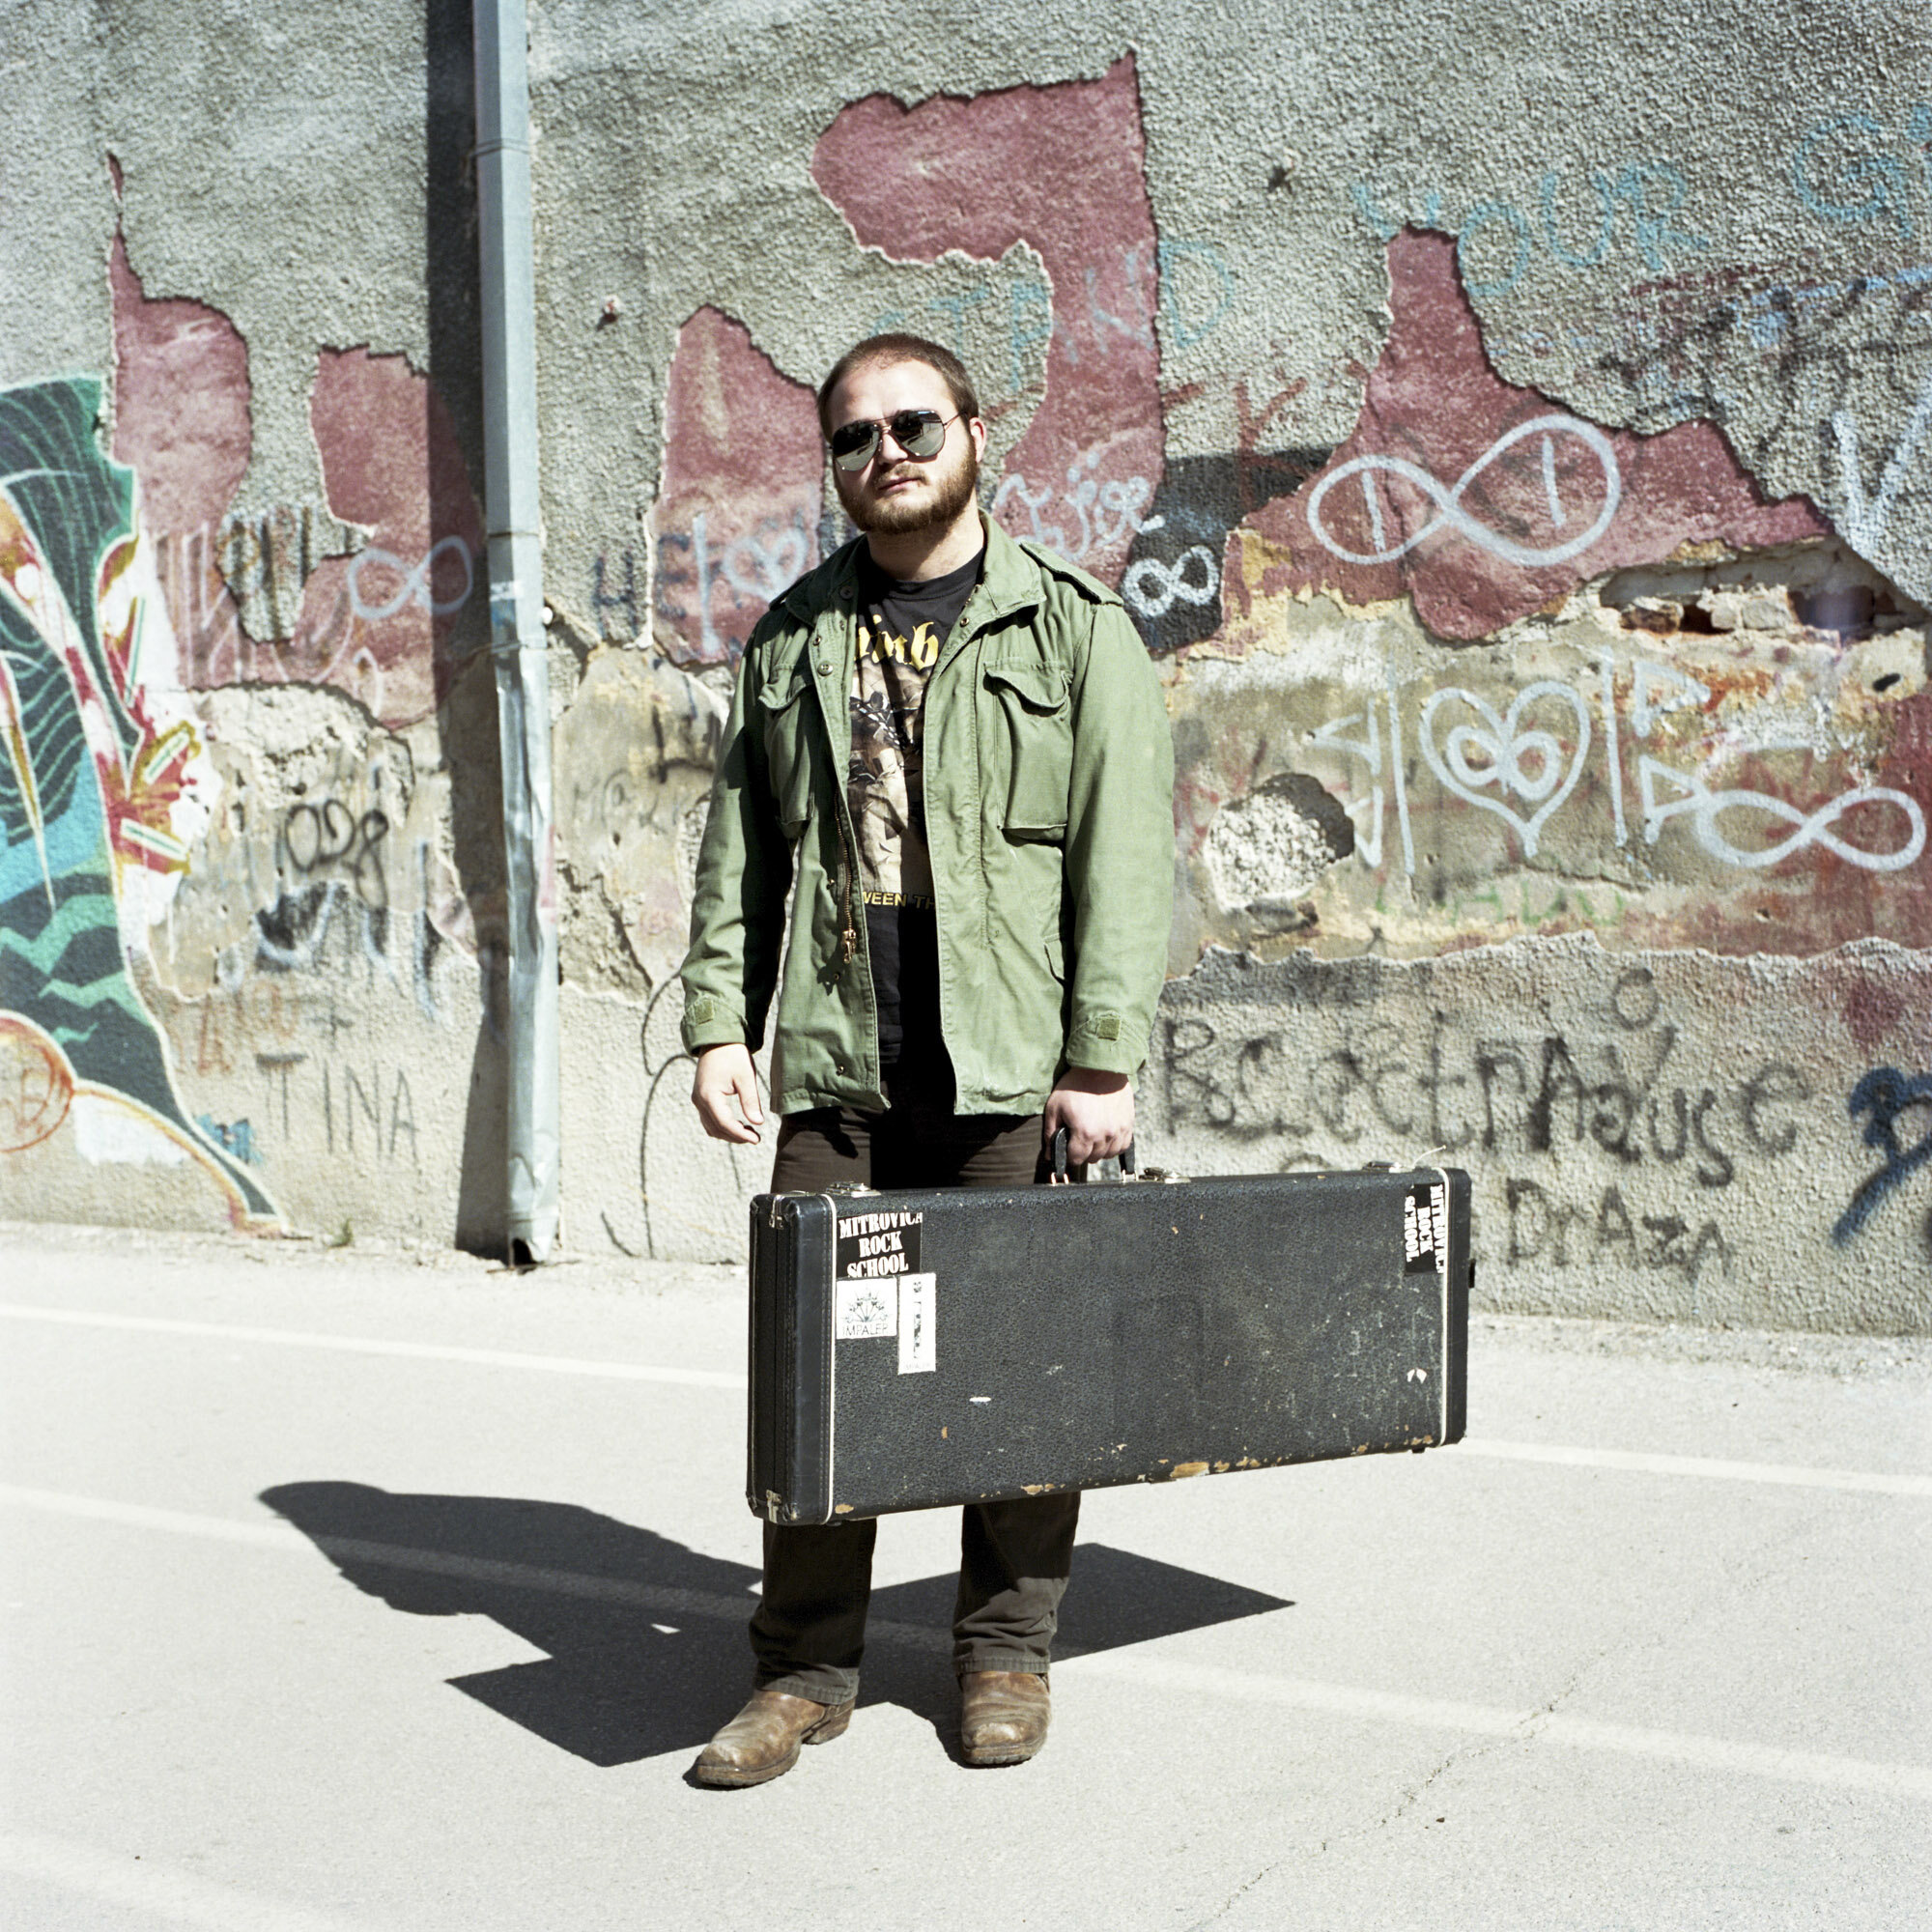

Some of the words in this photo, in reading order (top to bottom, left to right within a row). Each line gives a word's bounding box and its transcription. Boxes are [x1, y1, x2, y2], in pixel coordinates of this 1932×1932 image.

[858, 1230, 904, 1259] ROCK
[1404, 1195, 1420, 1263] SCHOOL
[1417, 1206, 1434, 1254] ROCK
[846, 1252, 910, 1278] SCHOOL
